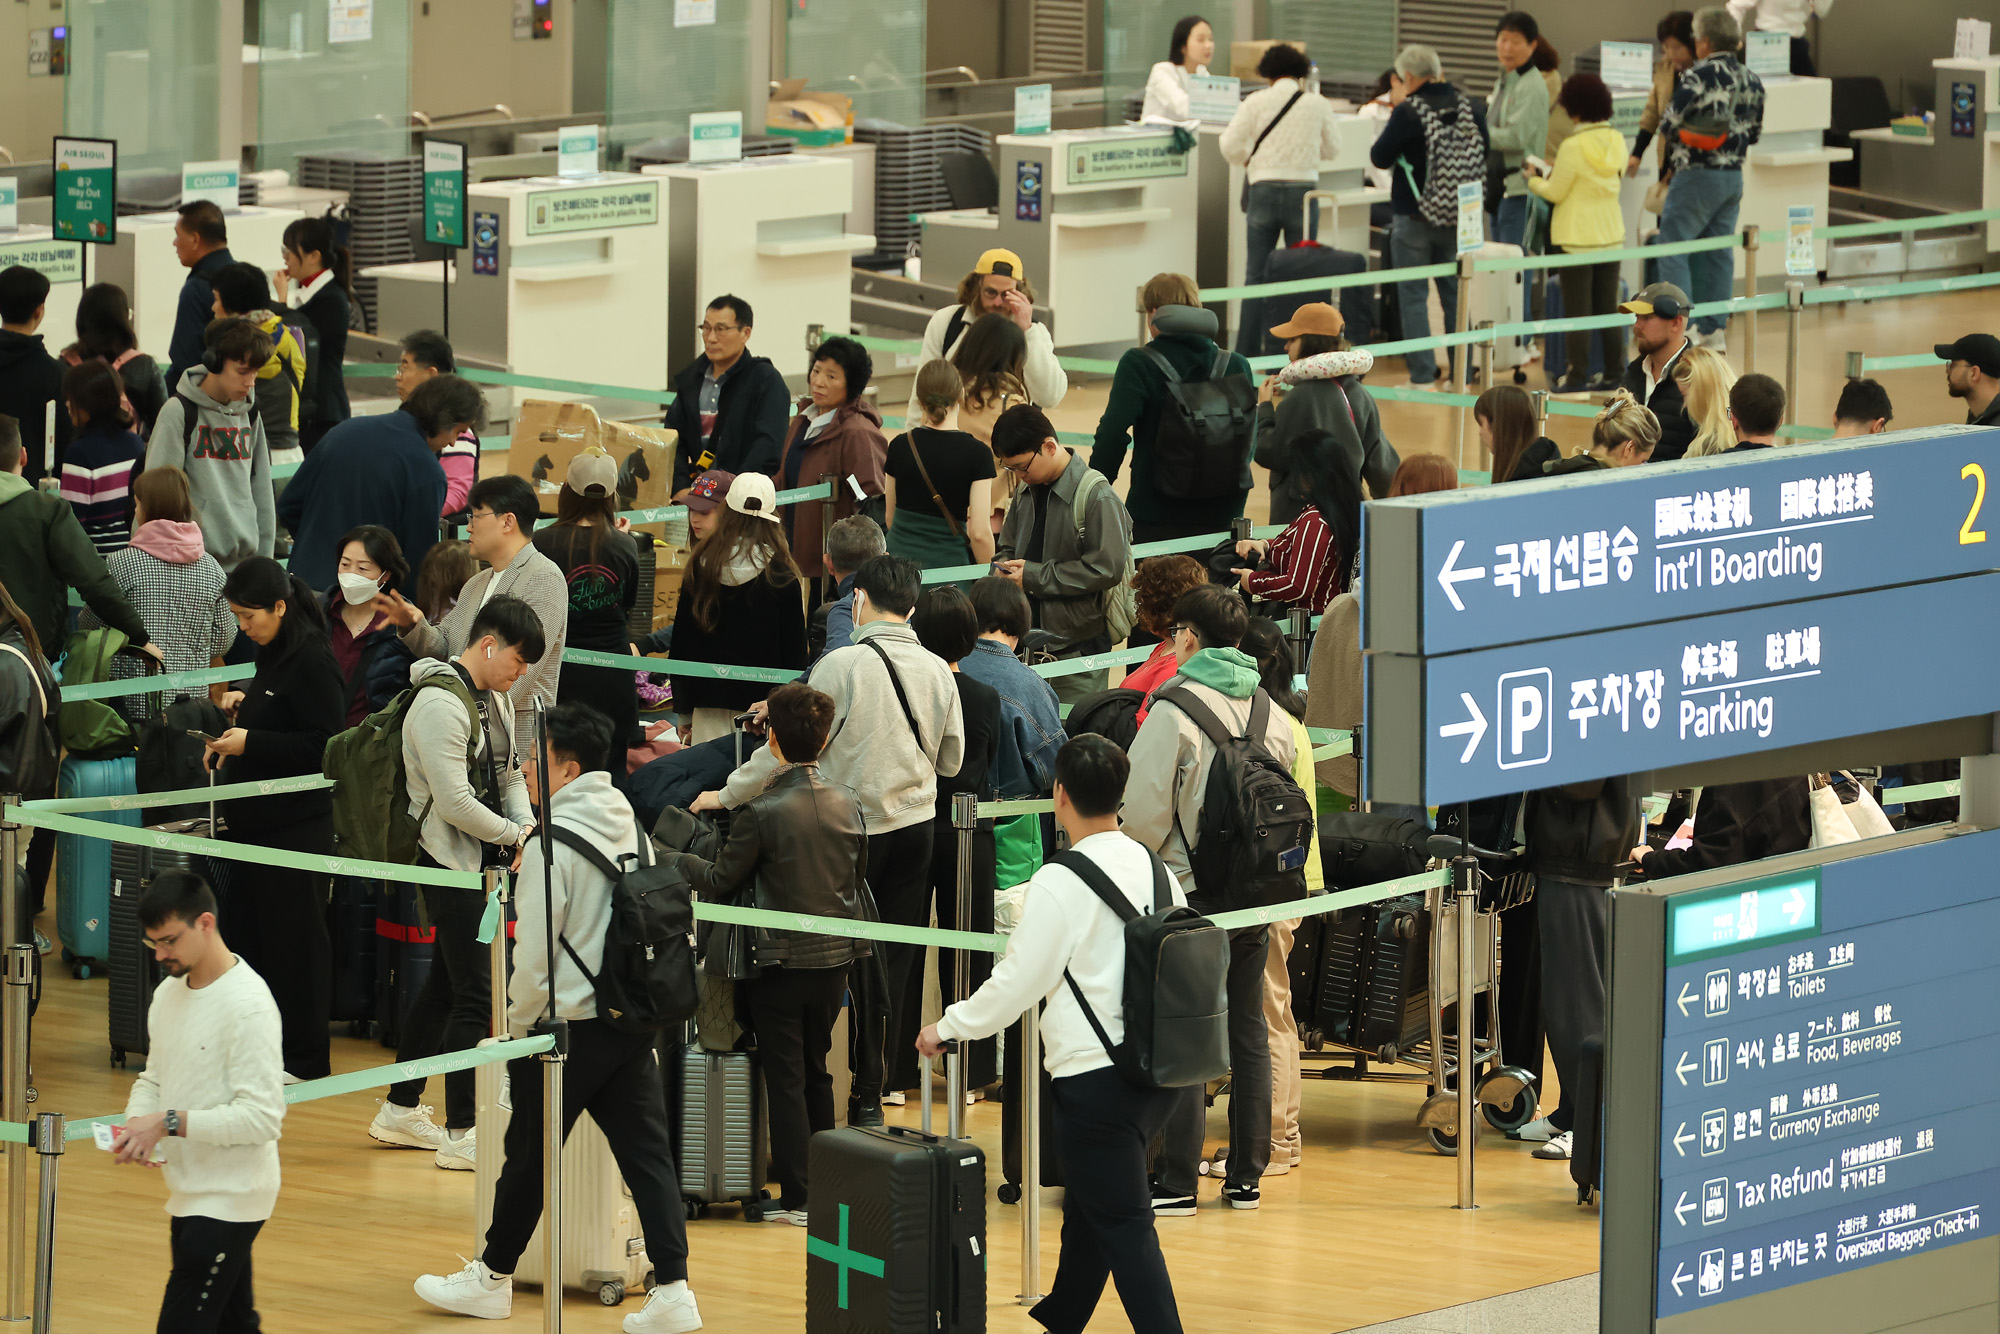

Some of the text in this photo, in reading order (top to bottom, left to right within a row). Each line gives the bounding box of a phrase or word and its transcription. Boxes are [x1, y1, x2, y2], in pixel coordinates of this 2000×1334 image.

[80, 150, 105, 159] SEOUL
[67, 186, 101, 198] Way Out
[193, 176, 229, 187] CLOSED
[22, 251, 38, 263] 각각
[62, 263, 75, 272] bag
[1780, 470, 1874, 522] 国際線搭乗
[1959, 462, 1986, 545] 2
[657, 511, 675, 520] Incheon
[1655, 487, 1753, 539] 国际线登机
[1494, 525, 1639, 598] 국제선탑승
[1655, 536, 1823, 593] Int'l Boarding
[568, 653, 615, 665] Incheon Airport
[1765, 626, 1821, 671] 駐車場
[1096, 655, 1134, 667] Incheon Airport
[1681, 639, 1738, 685] 停车场
[732, 671, 781, 680] Incheon Airport
[1568, 668, 1665, 740] 주차장
[1679, 690, 1774, 740] Parking
[1511, 685, 1543, 755] P
[274, 780, 317, 792] Incheon Airport
[172, 841, 222, 854] Incheon Airport
[344, 865, 395, 877] Incheon Airport
[1400, 878, 1439, 892] Incheon Airport
[1270, 906, 1309, 919] Incheon Airport
[845, 926, 870, 935] Airport
[1713, 928, 1734, 941] EXIT
[1787, 950, 1814, 975] お手洗
[1828, 942, 1855, 966] 卫生间
[1737, 965, 1781, 1000] 화장실
[1787, 976, 1826, 999] Toilets
[1841, 1009, 1860, 1032] 飲料
[1736, 1031, 1800, 1069] 식사, 음료
[1807, 1029, 1901, 1064] Food, Beverages
[420, 1058, 468, 1074] Incheon Airport
[1733, 1108, 1762, 1141] 환전
[1770, 1102, 1880, 1141] Currency Exchange
[1917, 1128, 1934, 1150] 退税
[1709, 1185, 1722, 1198] TAX
[1735, 1158, 1833, 1209] Tax Refund
[1836, 1210, 1980, 1263] Oversized Baggage Check-in
[1837, 1214, 1868, 1237] 大型行李
[1731, 1232, 1828, 1281] 큰 짐 부치는 곳
